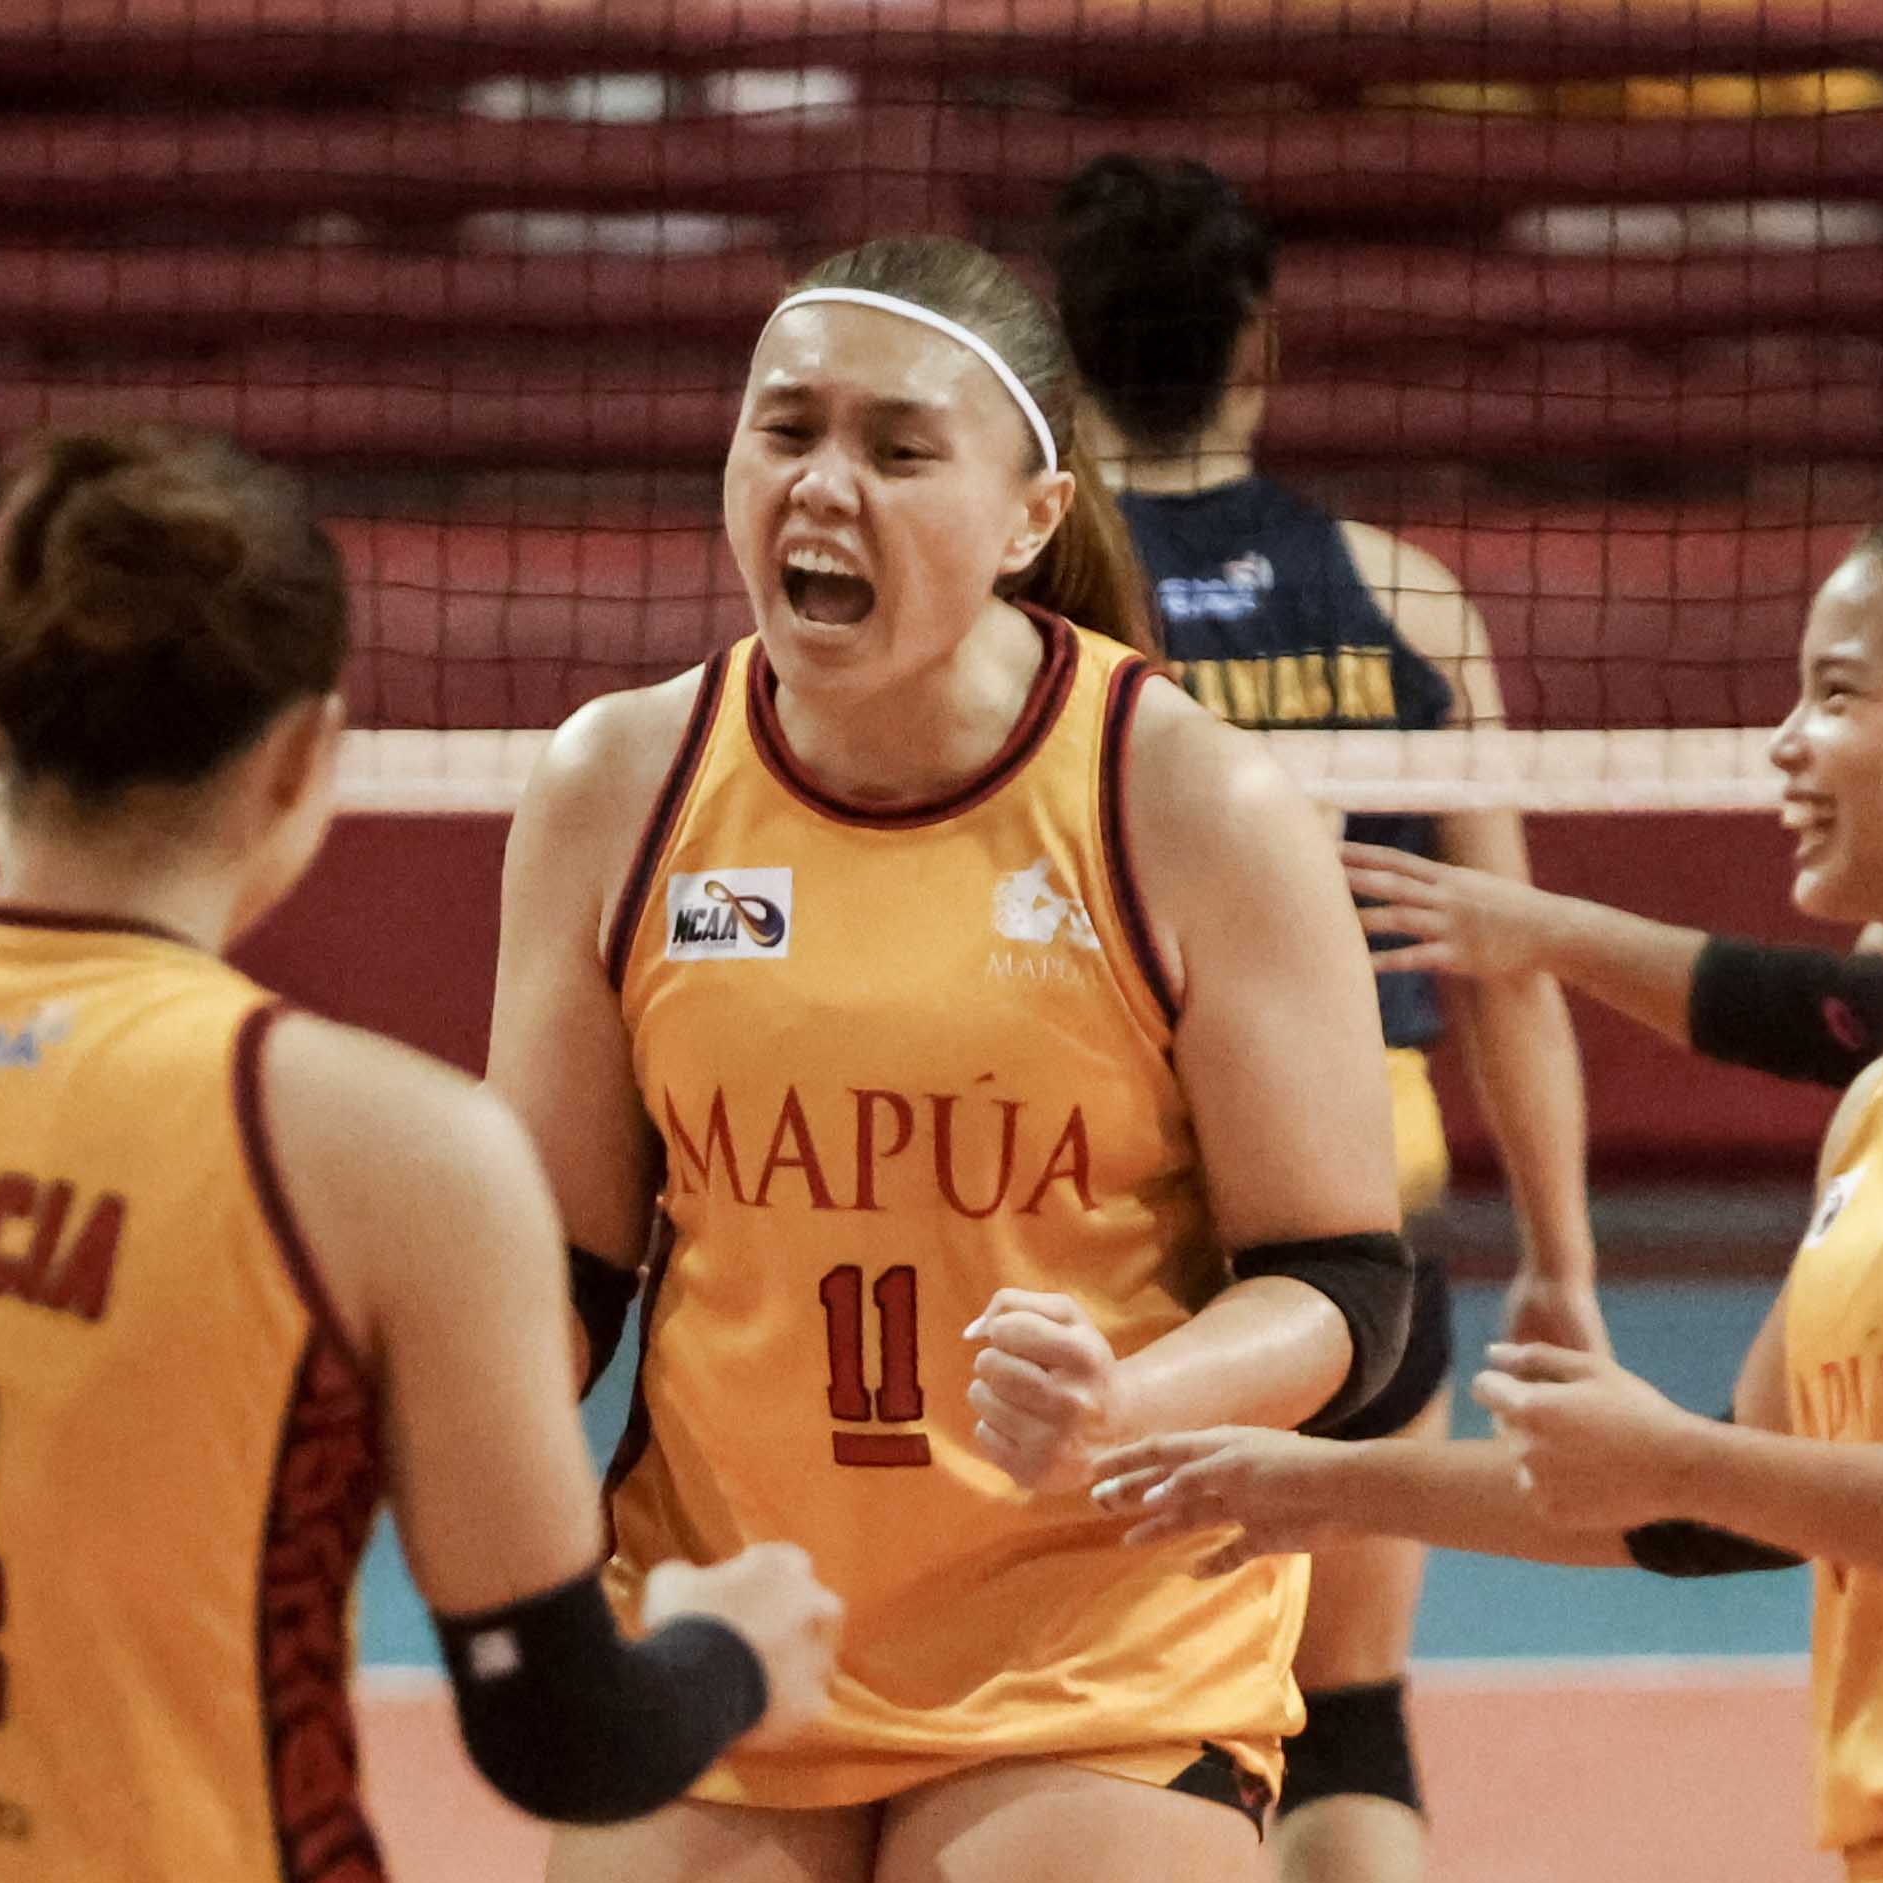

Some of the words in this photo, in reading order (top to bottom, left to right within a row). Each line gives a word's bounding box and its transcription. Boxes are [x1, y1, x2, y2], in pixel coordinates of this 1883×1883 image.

[673, 905, 738, 944] NCAA
[664, 1072, 1102, 1219] MAPÚA
[819, 1264, 924, 1423] 11
